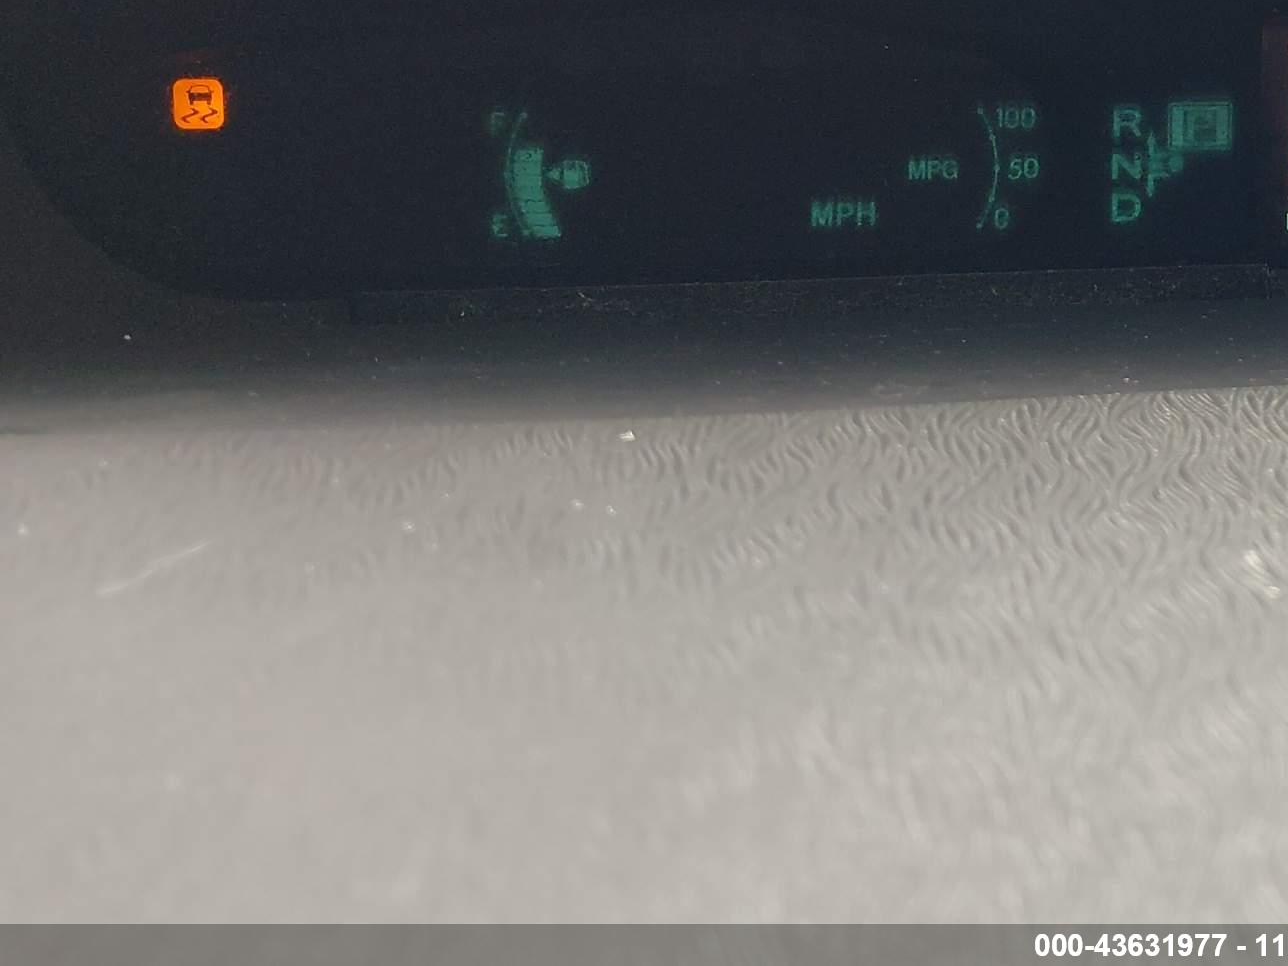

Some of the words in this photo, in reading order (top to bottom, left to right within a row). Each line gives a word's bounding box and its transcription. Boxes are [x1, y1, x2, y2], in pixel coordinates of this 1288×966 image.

[996, 106, 1036, 129] 100
[1111, 107, 1142, 138] R
[907, 158, 959, 181] MPG
[1007, 156, 1040, 180] 50
[1111, 152, 1142, 181] N
[810, 201, 877, 227] MPH
[994, 207, 1009, 230] 0
[1111, 192, 1142, 224] D
